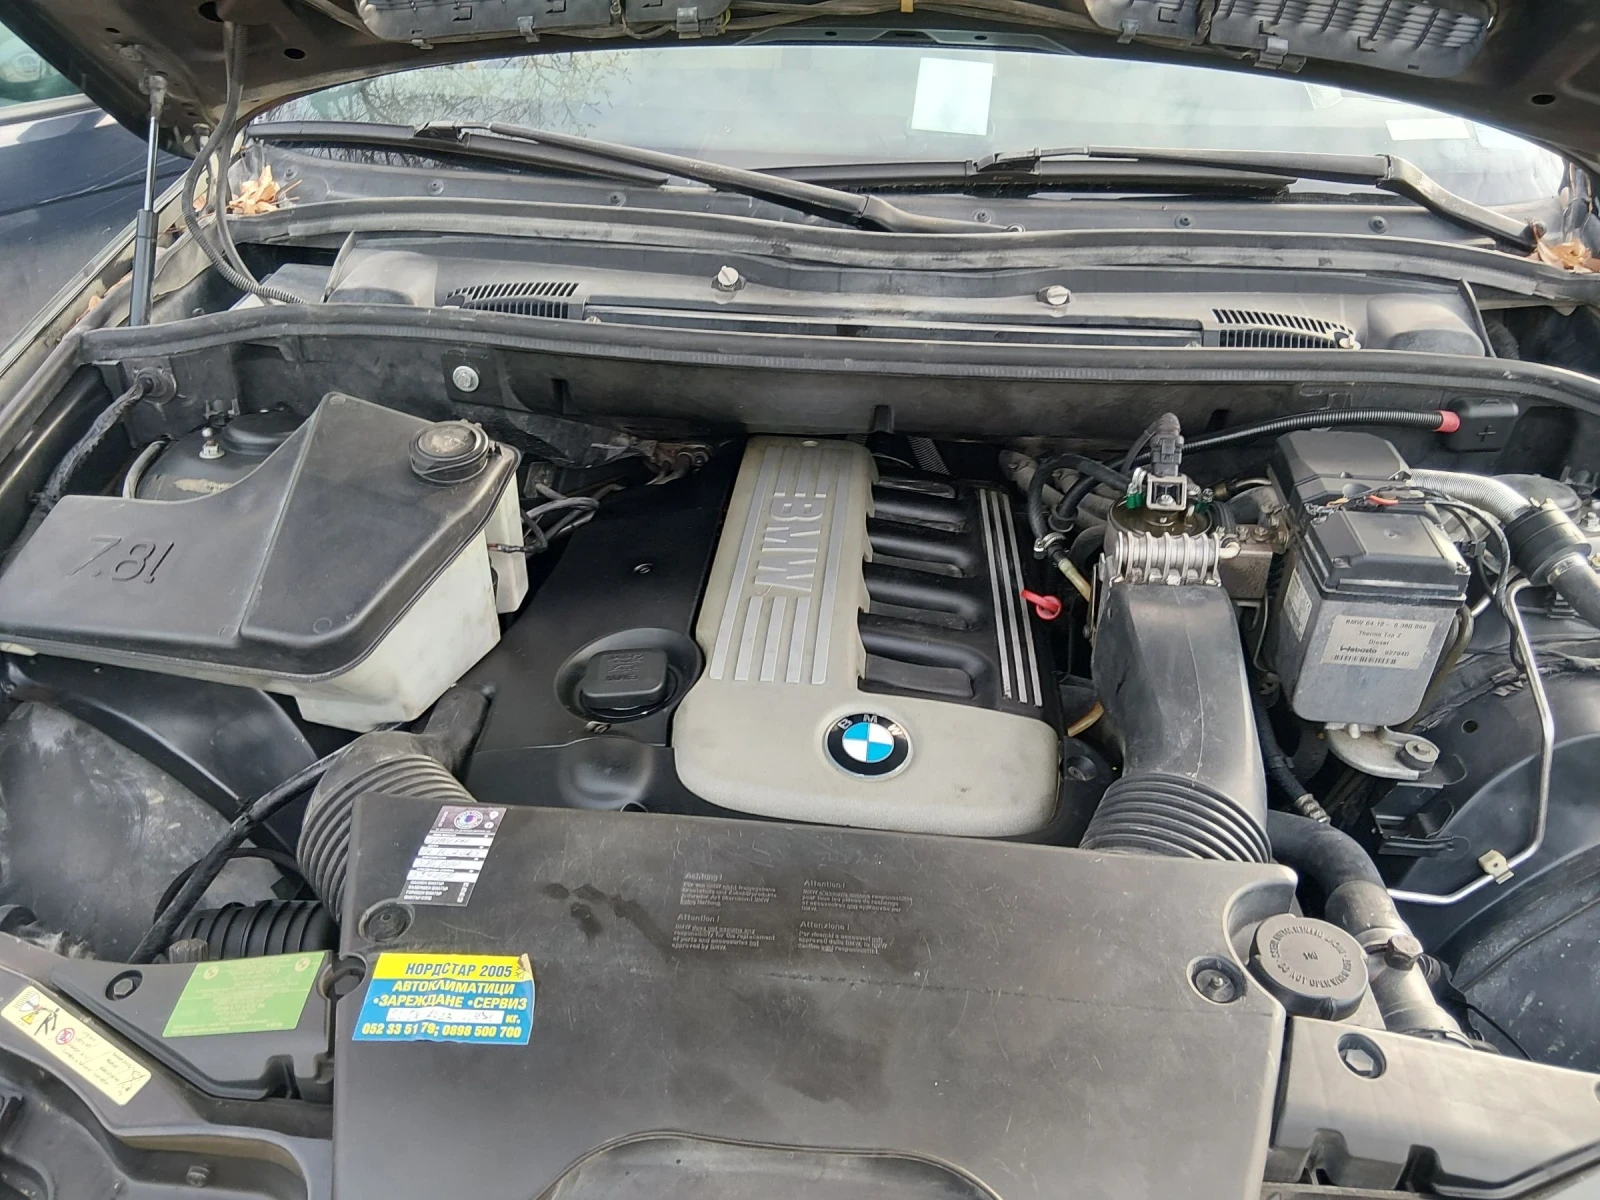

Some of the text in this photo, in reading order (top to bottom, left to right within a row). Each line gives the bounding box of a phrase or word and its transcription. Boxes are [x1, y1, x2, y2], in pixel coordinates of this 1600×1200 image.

[755, 493, 826, 592] BMW
[1339, 645, 1378, 654] Webasto
[838, 714, 903, 736] BMW
[804, 879, 841, 889] Attention
[677, 913, 715, 923] Attention
[800, 921, 845, 930] Attenzione
[405, 962, 513, 977] НОРДСТАР 2005
[392, 980, 515, 996] АВТОКЛИМАТИЦИ
[362, 1023, 385, 1035] 052
[386, 1023, 402, 1035] 33
[404, 1023, 418, 1035] 51
[442, 1025, 472, 1036] 0898
[474, 1025, 497, 1037] 500
[500, 1026, 522, 1038] 700
